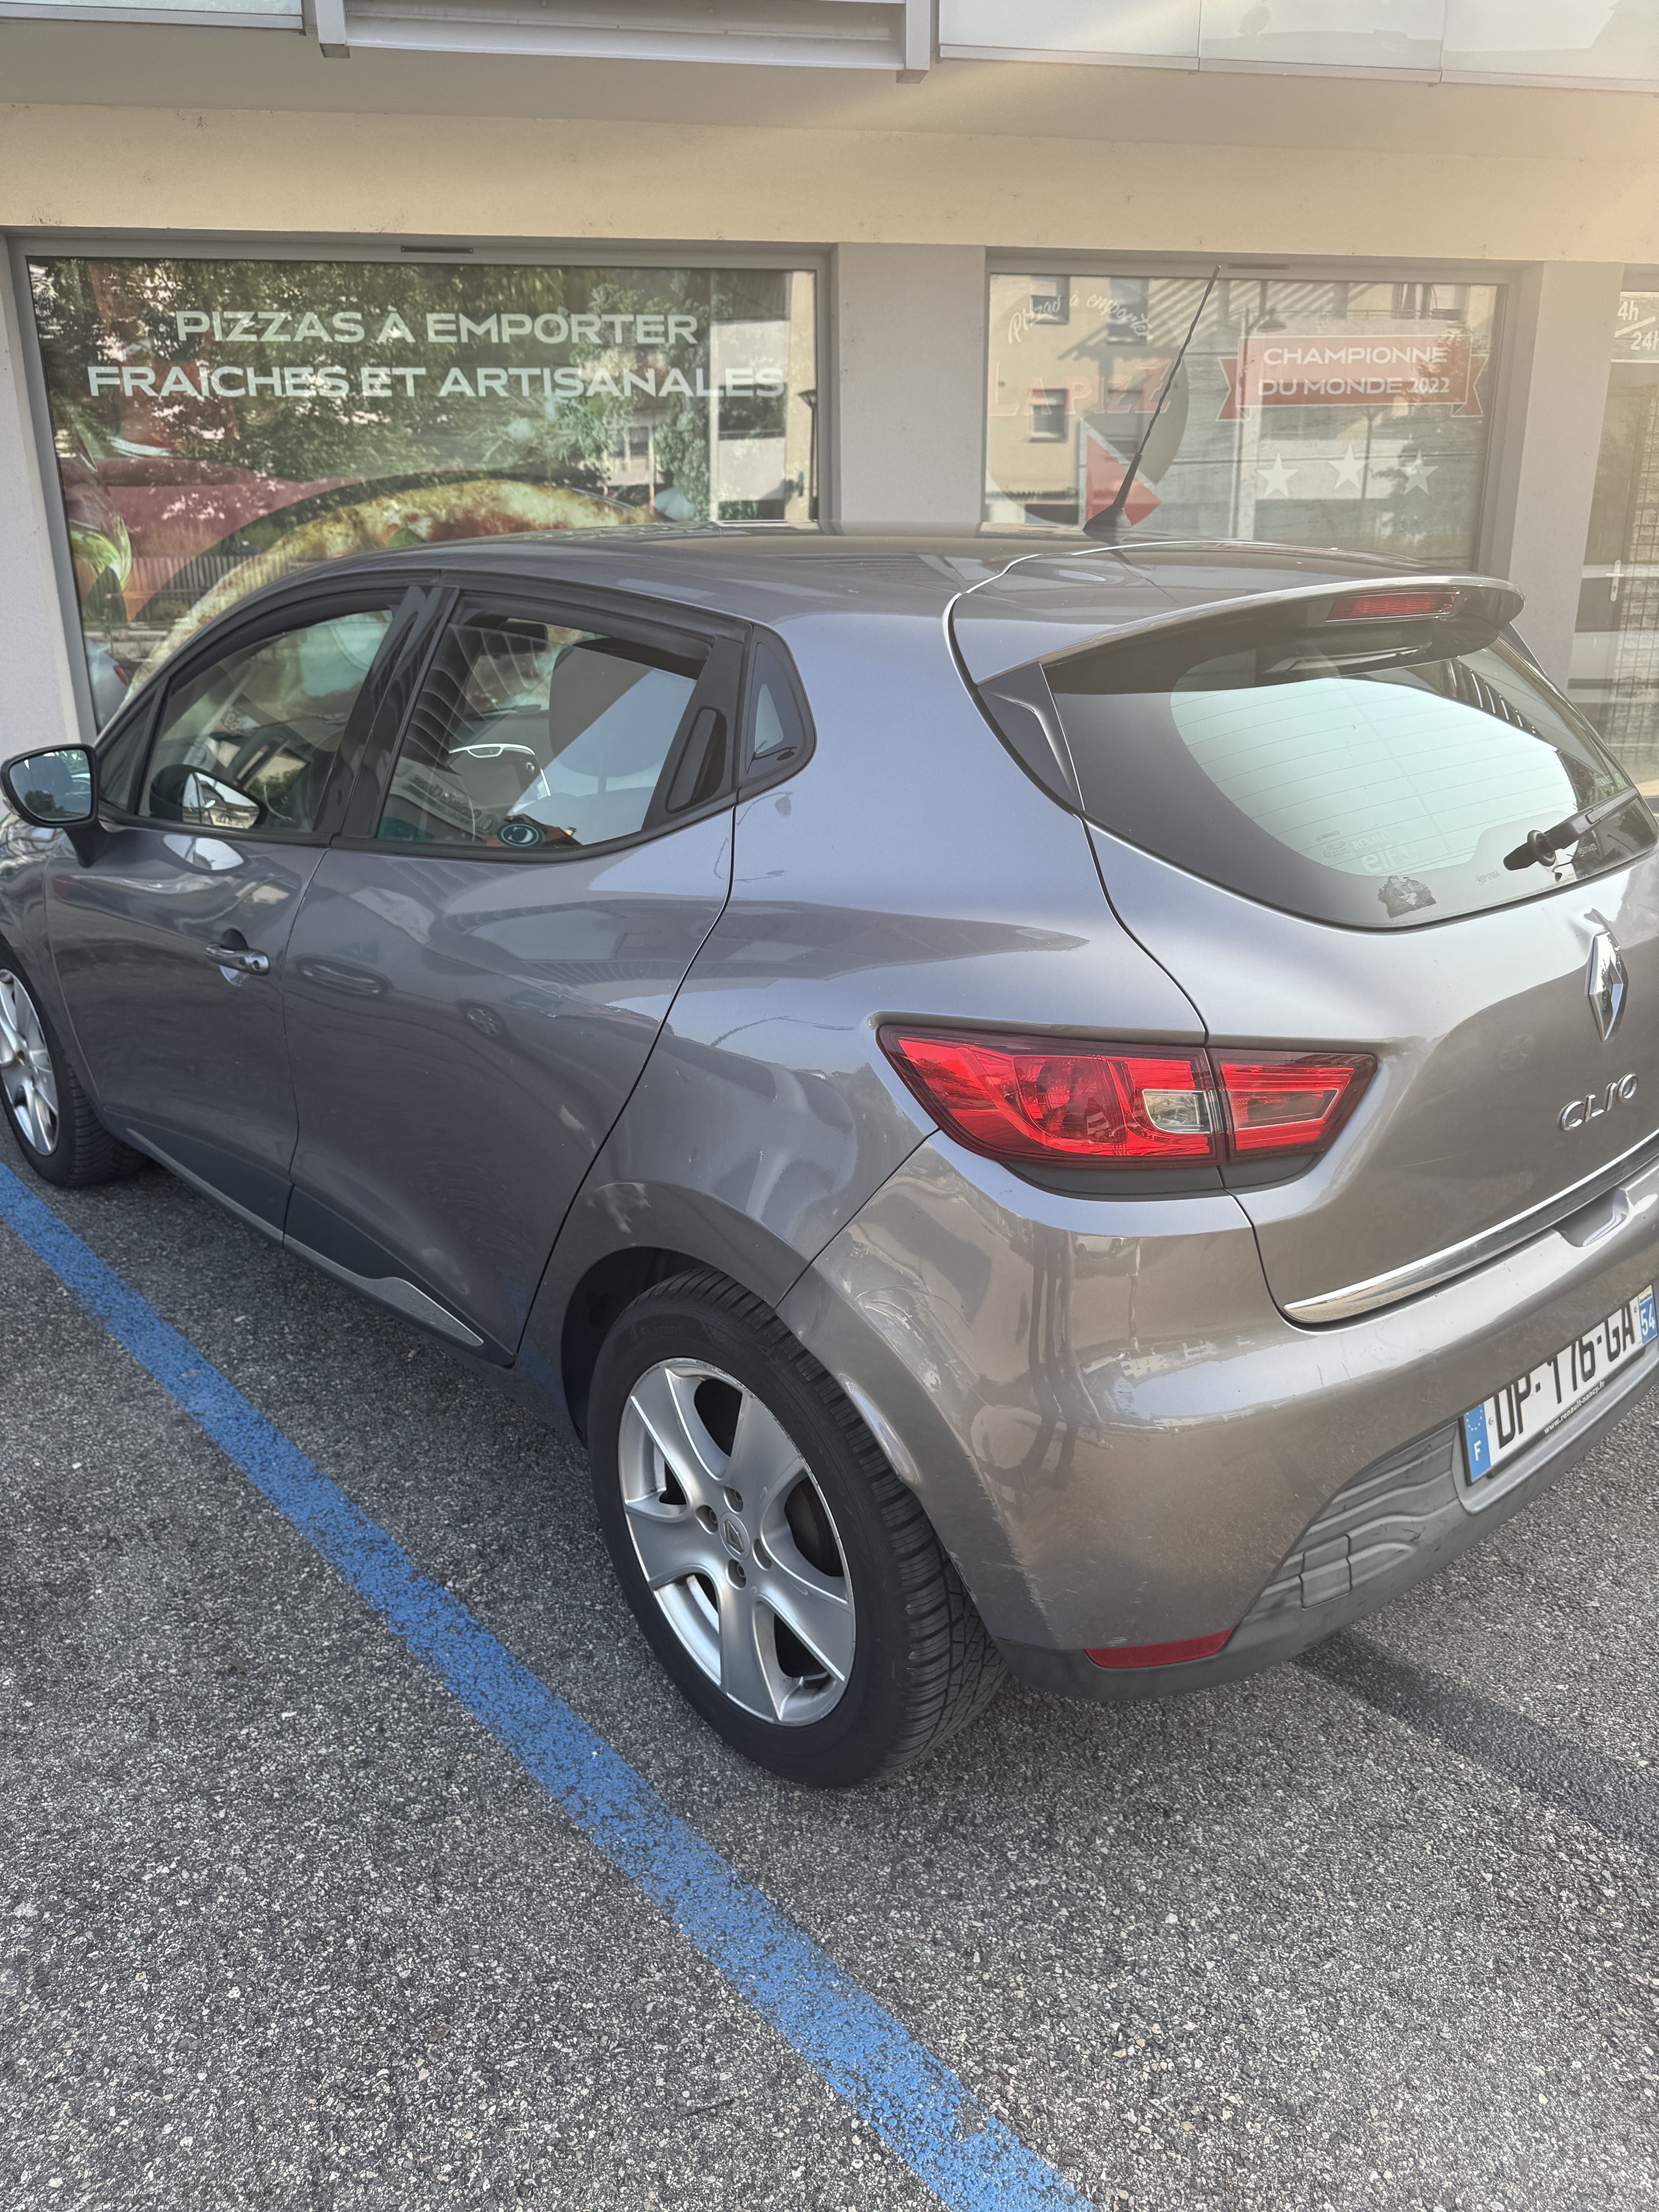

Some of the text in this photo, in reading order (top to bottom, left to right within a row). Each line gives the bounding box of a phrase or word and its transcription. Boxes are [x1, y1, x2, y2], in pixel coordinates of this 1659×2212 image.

[176, 305, 697, 344] PIZZAS À EMPORTER
[1264, 346, 1448, 365] CHAMPIONNE
[88, 360, 785, 397] FRAÎCHES ET ARTISANALES
[1259, 376, 1450, 396] DU MONDE 2022
[1557, 1072, 1639, 1131] CLIO
[1640, 1303, 1655, 1336] 54
[1544, 1380, 1605, 1434] www.renault-nancy.fr
[1474, 1440, 1482, 1461] F
